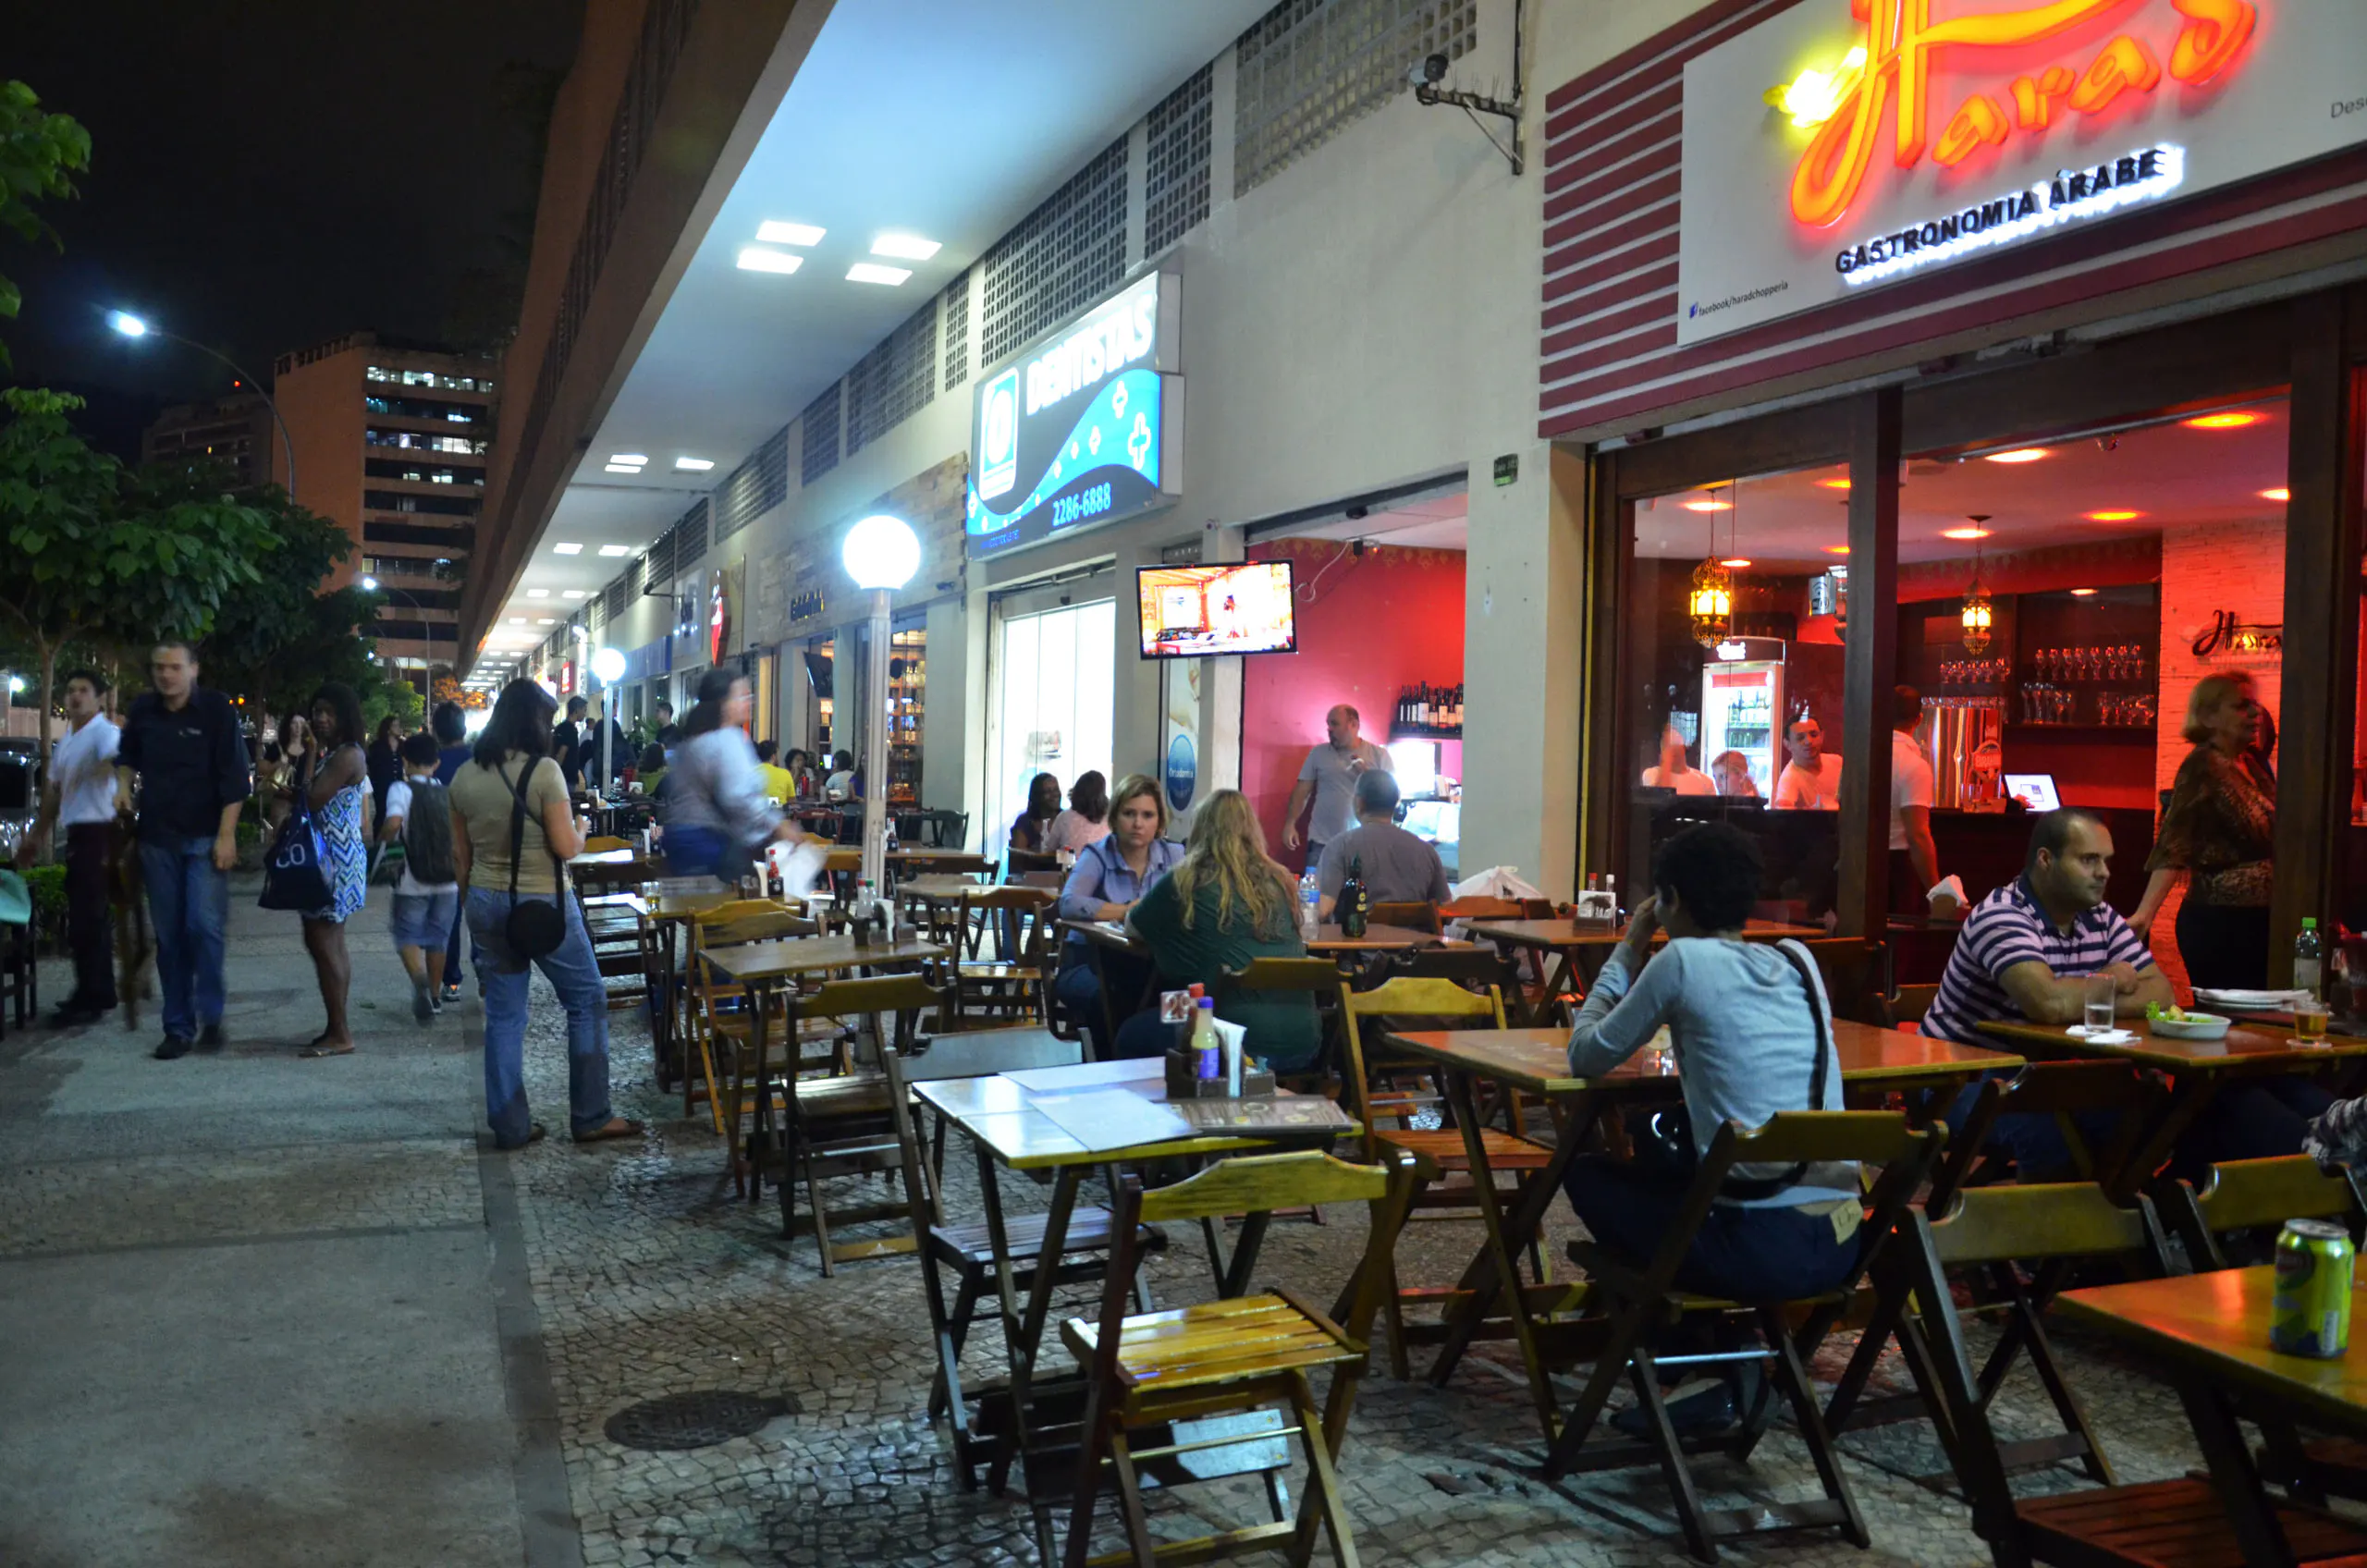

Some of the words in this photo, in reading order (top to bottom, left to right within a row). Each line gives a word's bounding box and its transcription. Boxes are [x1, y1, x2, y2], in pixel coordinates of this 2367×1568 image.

[2331, 96, 2367, 118] Des
[1834, 190, 2037, 274] GASTRONOMIA
[2048, 149, 2168, 210] ÁRABE
